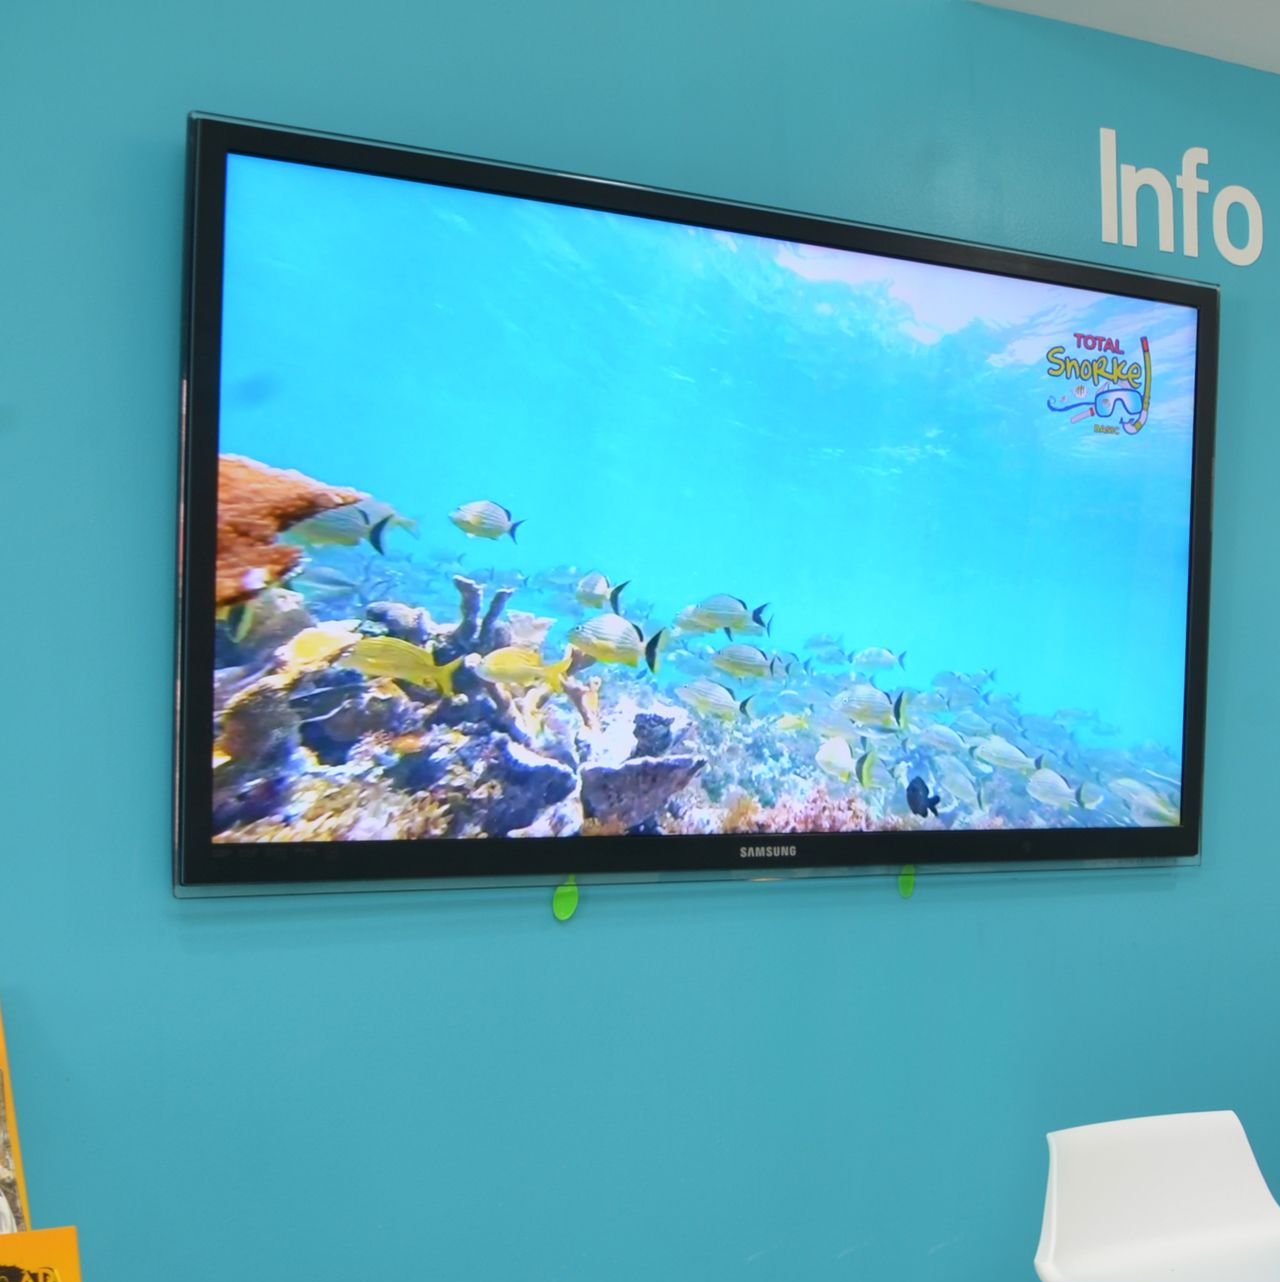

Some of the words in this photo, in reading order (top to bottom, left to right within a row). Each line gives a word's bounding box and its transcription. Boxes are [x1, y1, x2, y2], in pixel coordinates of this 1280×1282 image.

[1100, 127, 1263, 266] Info
[1073, 333, 1125, 355] TOTAL
[739, 845, 797, 858] SAMSUNG
